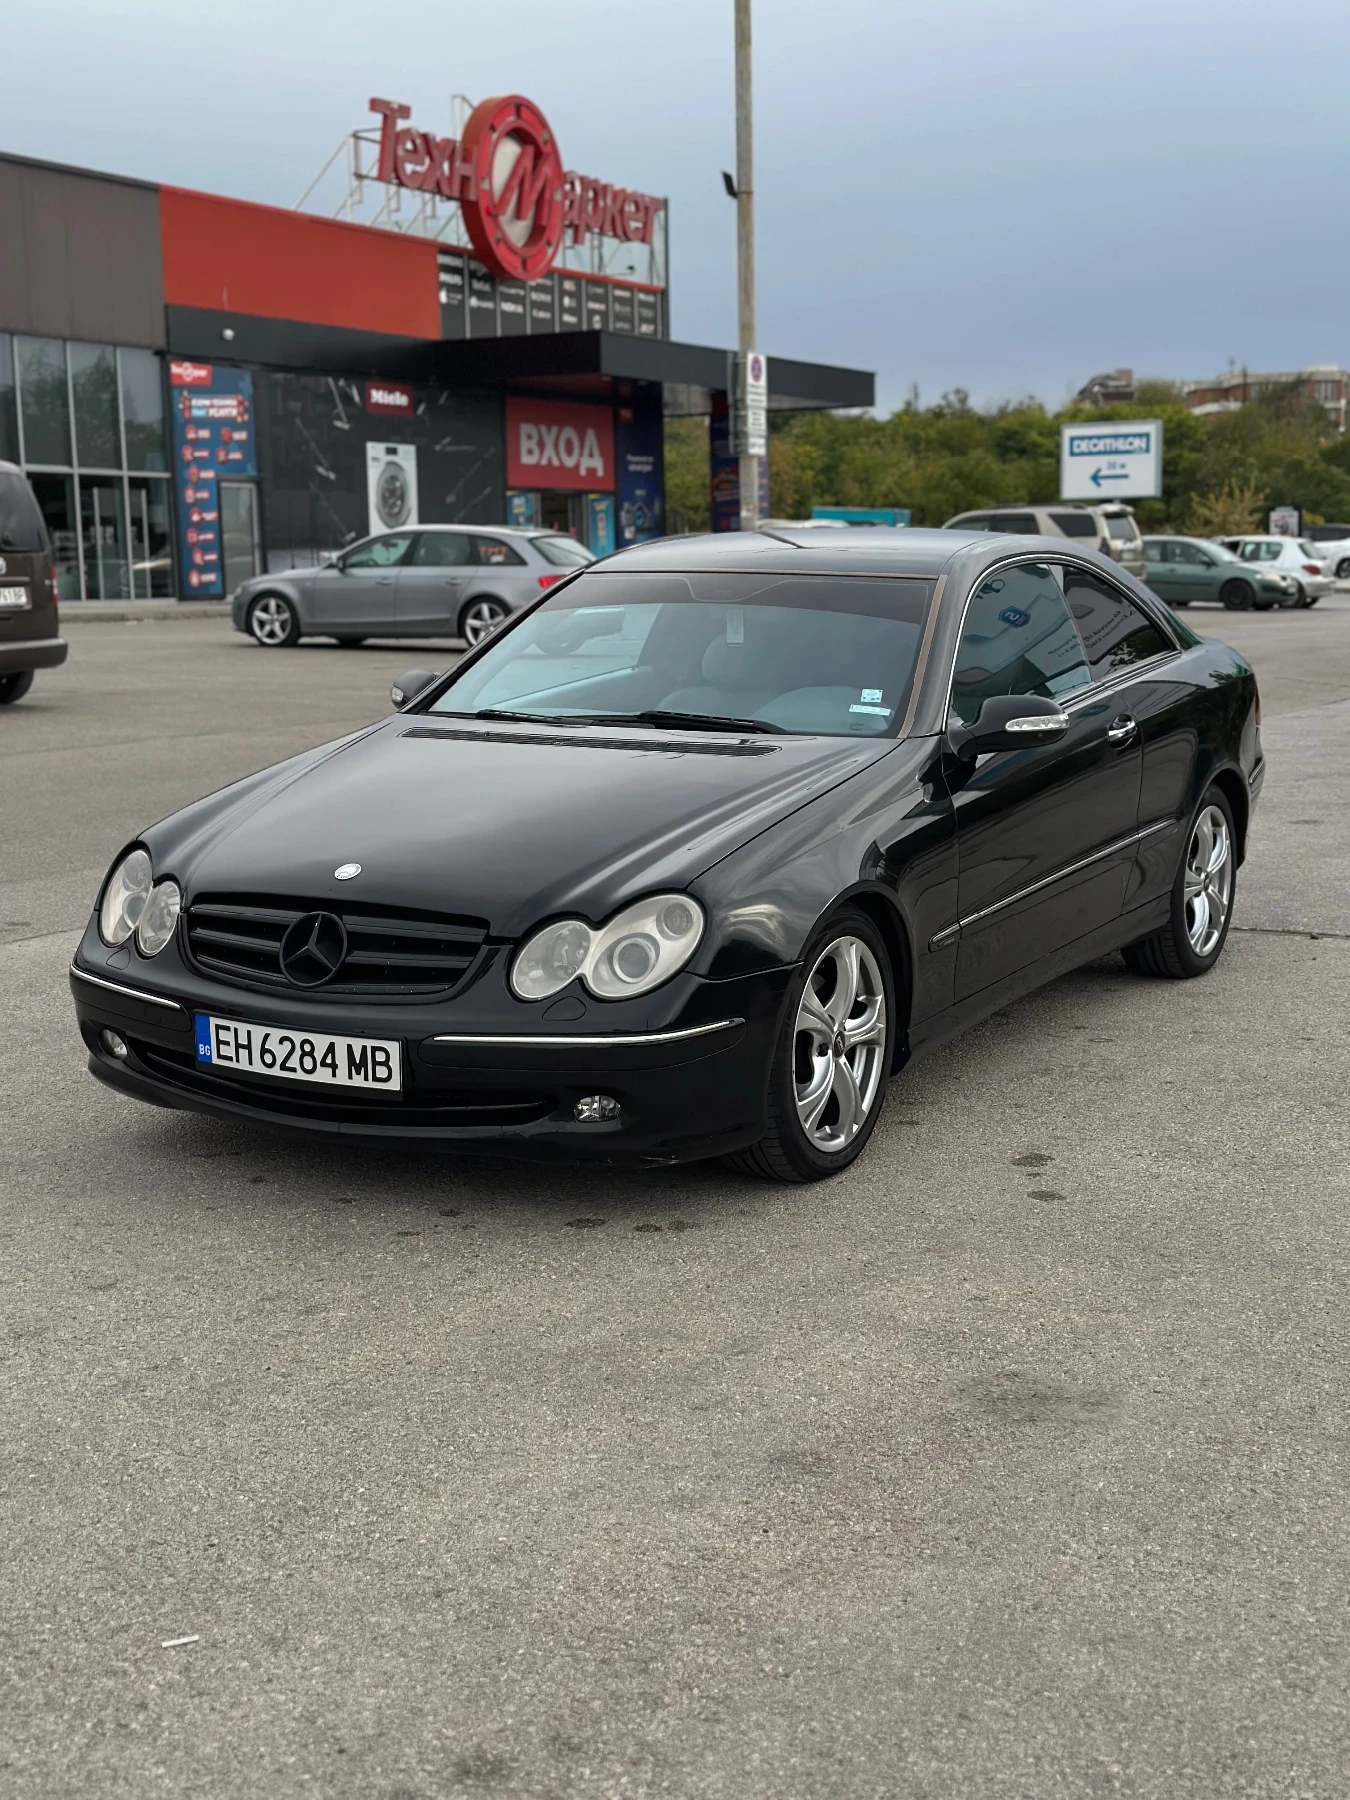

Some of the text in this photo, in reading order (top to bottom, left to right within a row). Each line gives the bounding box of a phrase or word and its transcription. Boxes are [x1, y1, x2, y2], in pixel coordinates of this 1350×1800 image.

[370, 388, 409, 407] Miele
[519, 422, 604, 477] ВХОД
[1072, 436, 1147, 453] DECATHLON
[198, 1043, 211, 1056] BG
[214, 1023, 393, 1083] EH 6284 MB
